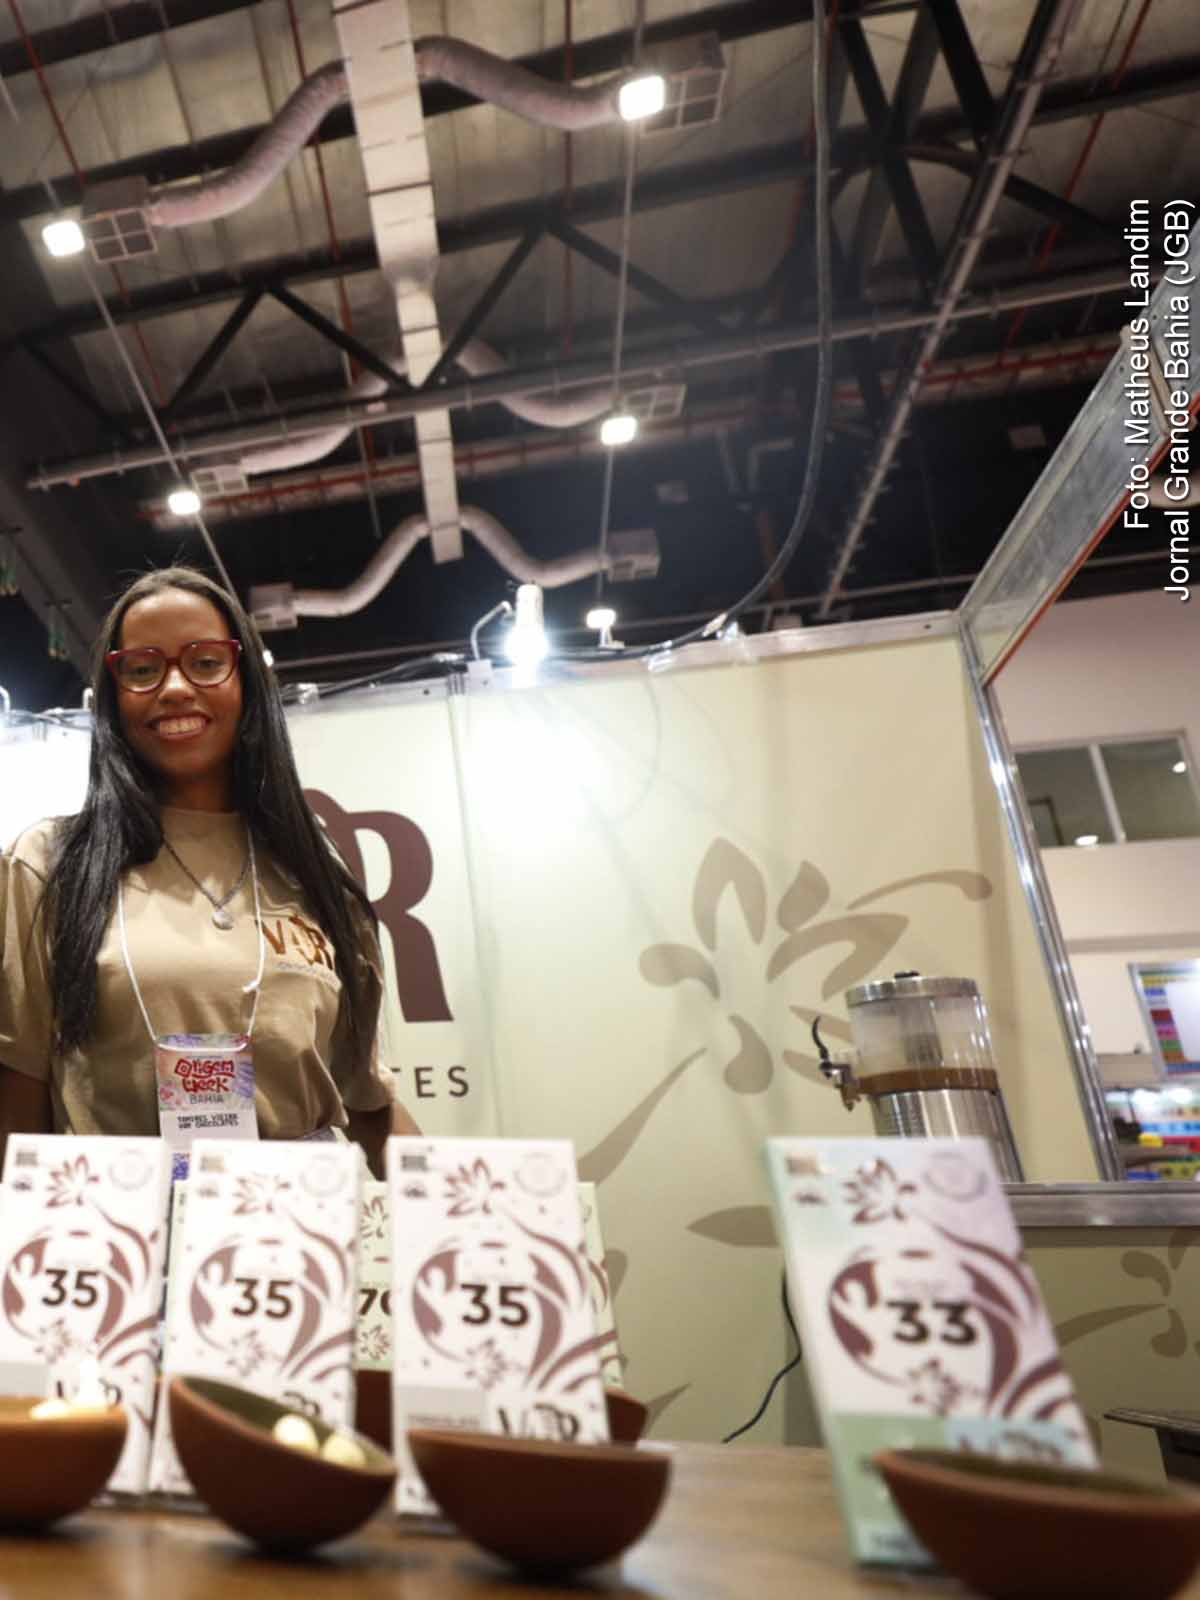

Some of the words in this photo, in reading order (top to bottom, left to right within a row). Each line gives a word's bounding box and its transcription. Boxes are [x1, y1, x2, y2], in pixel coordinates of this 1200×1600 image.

[189, 1094, 224, 1104] BAHIA
[42, 1268, 100, 1309] 35
[231, 1277, 294, 1319] 35
[460, 1282, 530, 1328] 35
[886, 1300, 979, 1345] 33
